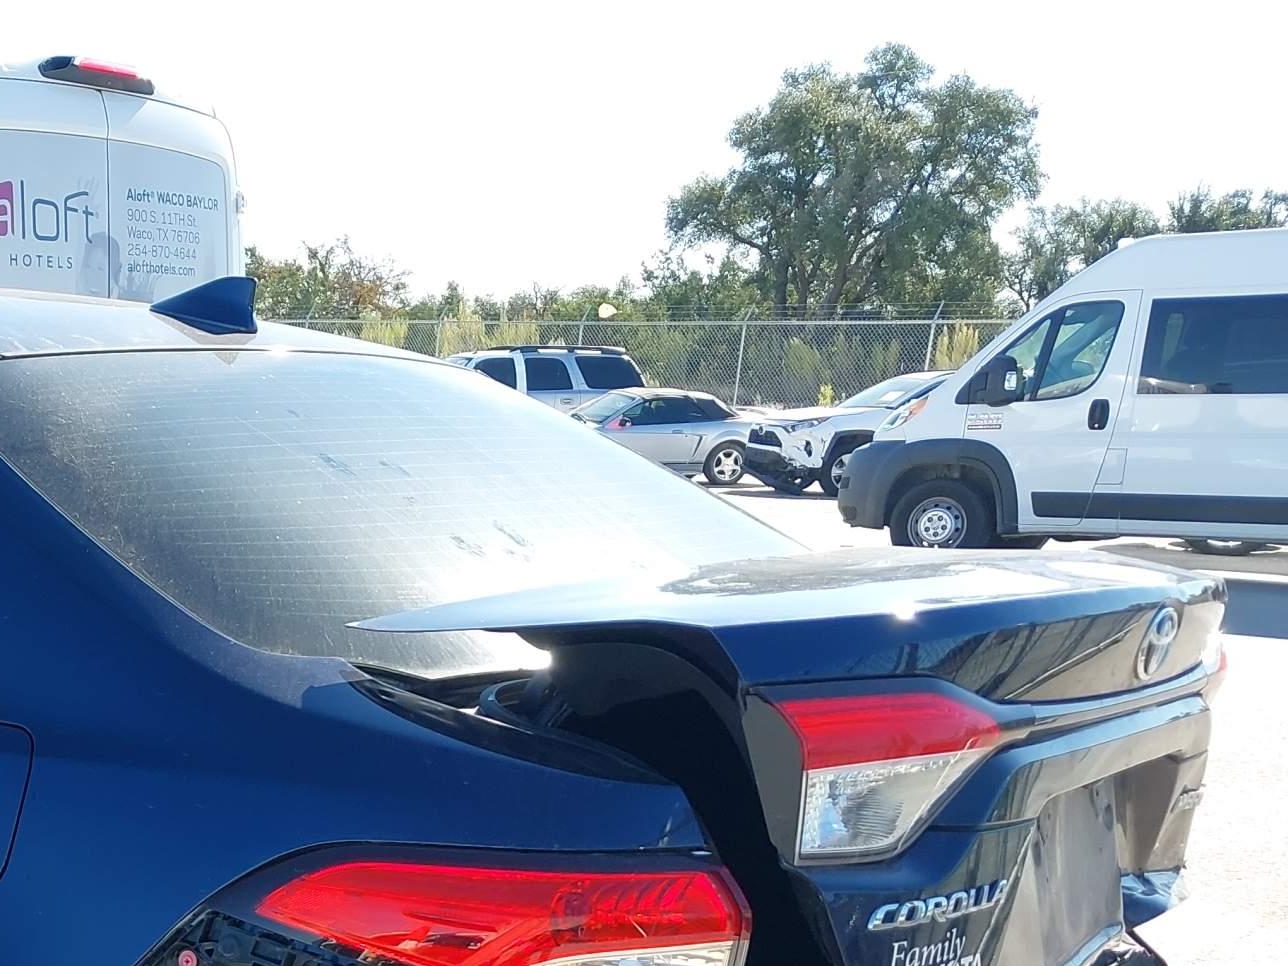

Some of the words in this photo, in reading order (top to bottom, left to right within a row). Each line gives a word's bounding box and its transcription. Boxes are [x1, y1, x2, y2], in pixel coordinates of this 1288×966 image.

[156, 190, 185, 207] WACO
[186, 194, 219, 211] BAYLOR
[127, 208, 148, 223] 900
[149, 210, 160, 224] S.
[161, 212, 186, 226] 11TH
[127, 225, 156, 242] Waco,
[156, 227, 170, 242] TX
[171, 229, 201, 245] 76706
[127, 243, 197, 260] 254-870-4644
[9, 252, 74, 270] HOTELS
[127, 261, 195, 277] alofthotels.com
[867, 879, 1008, 931] COROLLA
